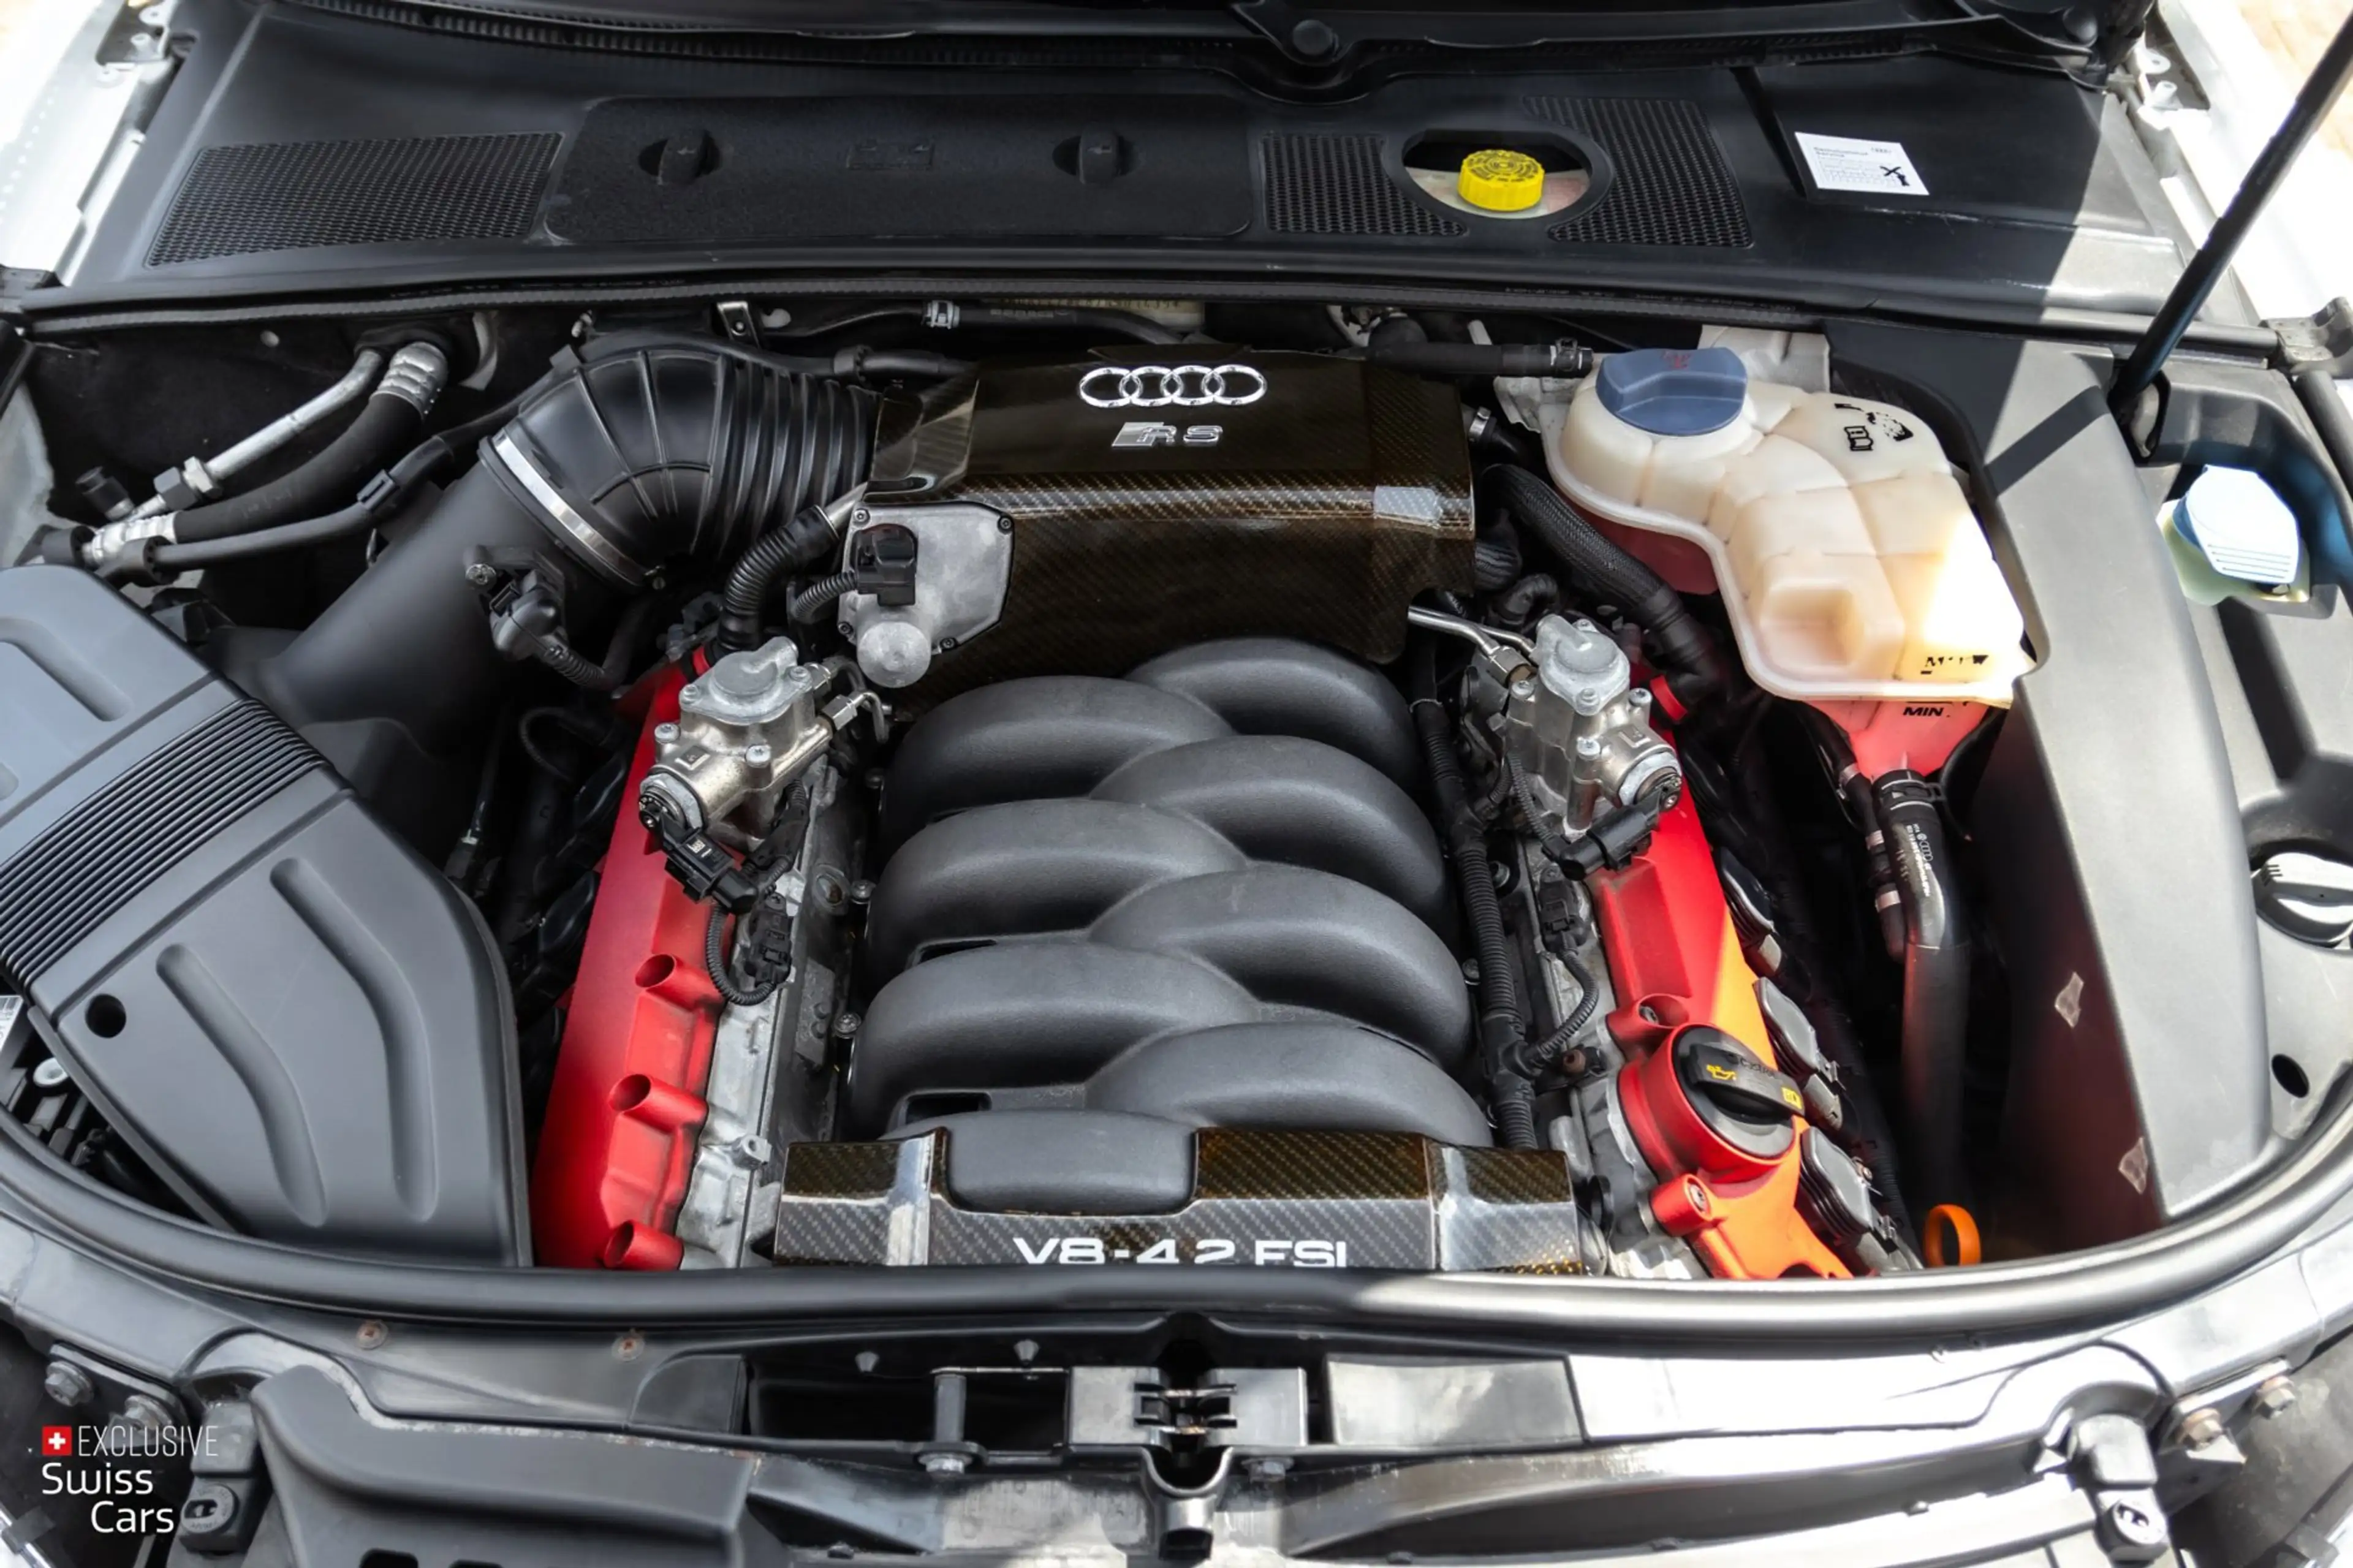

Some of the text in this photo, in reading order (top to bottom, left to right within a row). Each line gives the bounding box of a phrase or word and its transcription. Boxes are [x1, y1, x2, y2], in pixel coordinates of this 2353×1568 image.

[1112, 421, 1223, 447] RS
[1903, 706, 1944, 717] MIN
[1254, 1240, 1347, 1268] FSI
